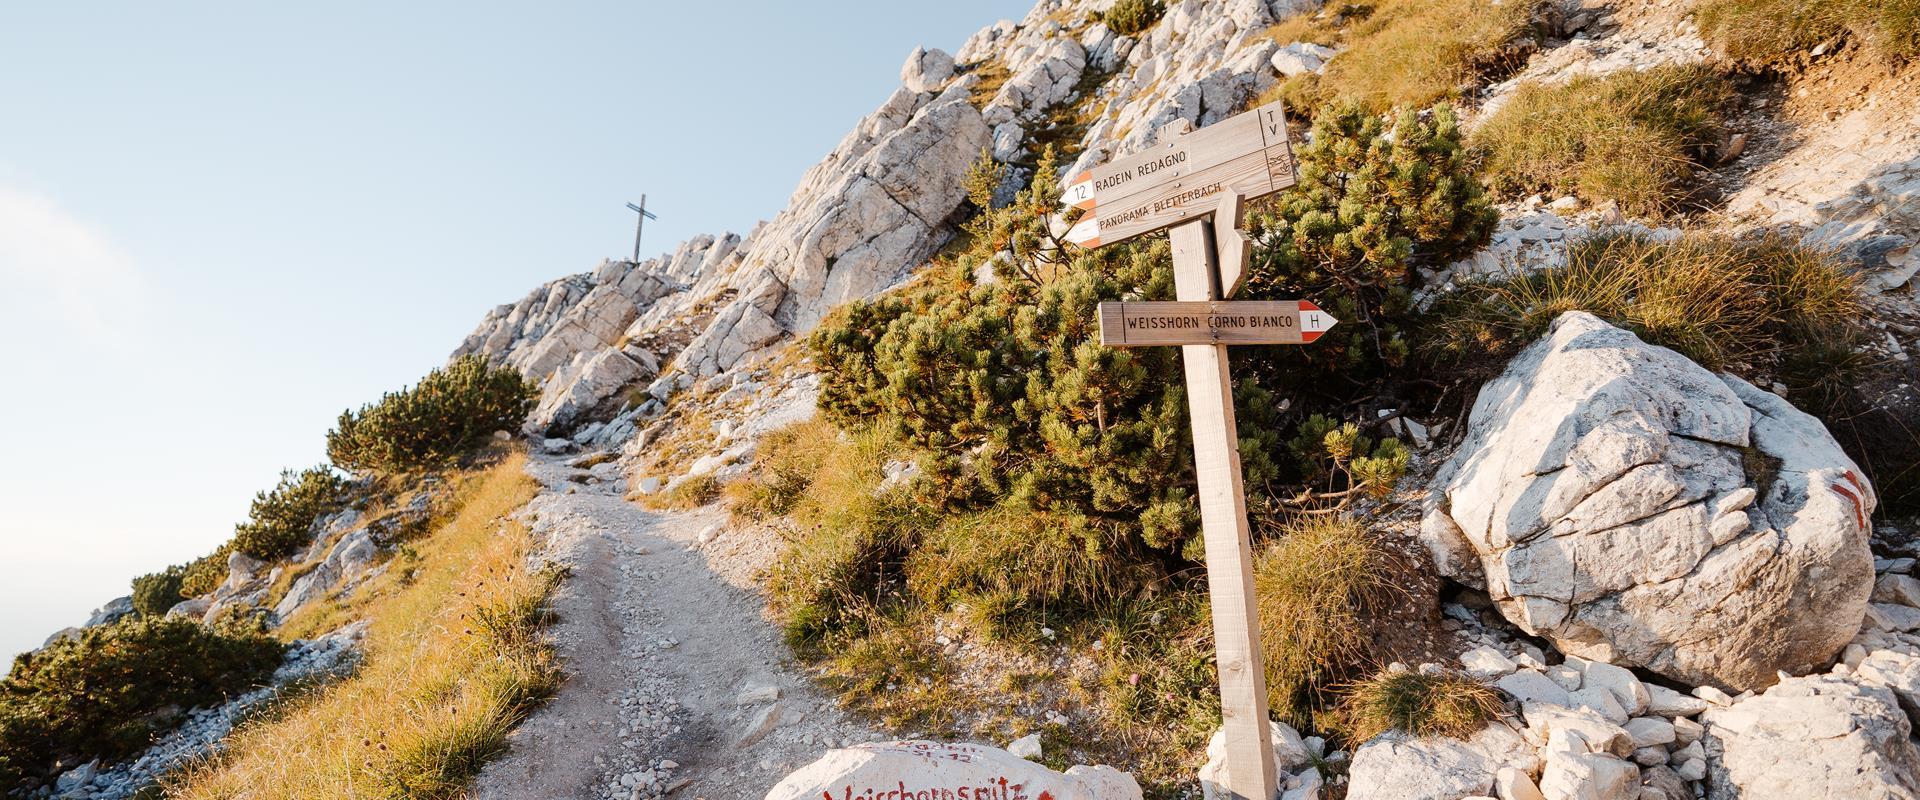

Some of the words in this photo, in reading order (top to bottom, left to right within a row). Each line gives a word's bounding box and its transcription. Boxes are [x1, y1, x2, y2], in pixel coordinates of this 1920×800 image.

[1267, 110, 1274, 122] T
[1269, 124, 1277, 136] V
[1095, 170, 1132, 192] RADEIN
[1137, 150, 1186, 177] REDAGNO
[1074, 185, 1087, 201] 12
[1099, 207, 1150, 230] PANORAMA
[1153, 182, 1222, 212] BLETTERBACH
[1127, 316, 1199, 329] WEISSHORN
[1207, 316, 1246, 328] CORNO
[1250, 315, 1293, 328] BIANCO
[1310, 314, 1320, 329] H
